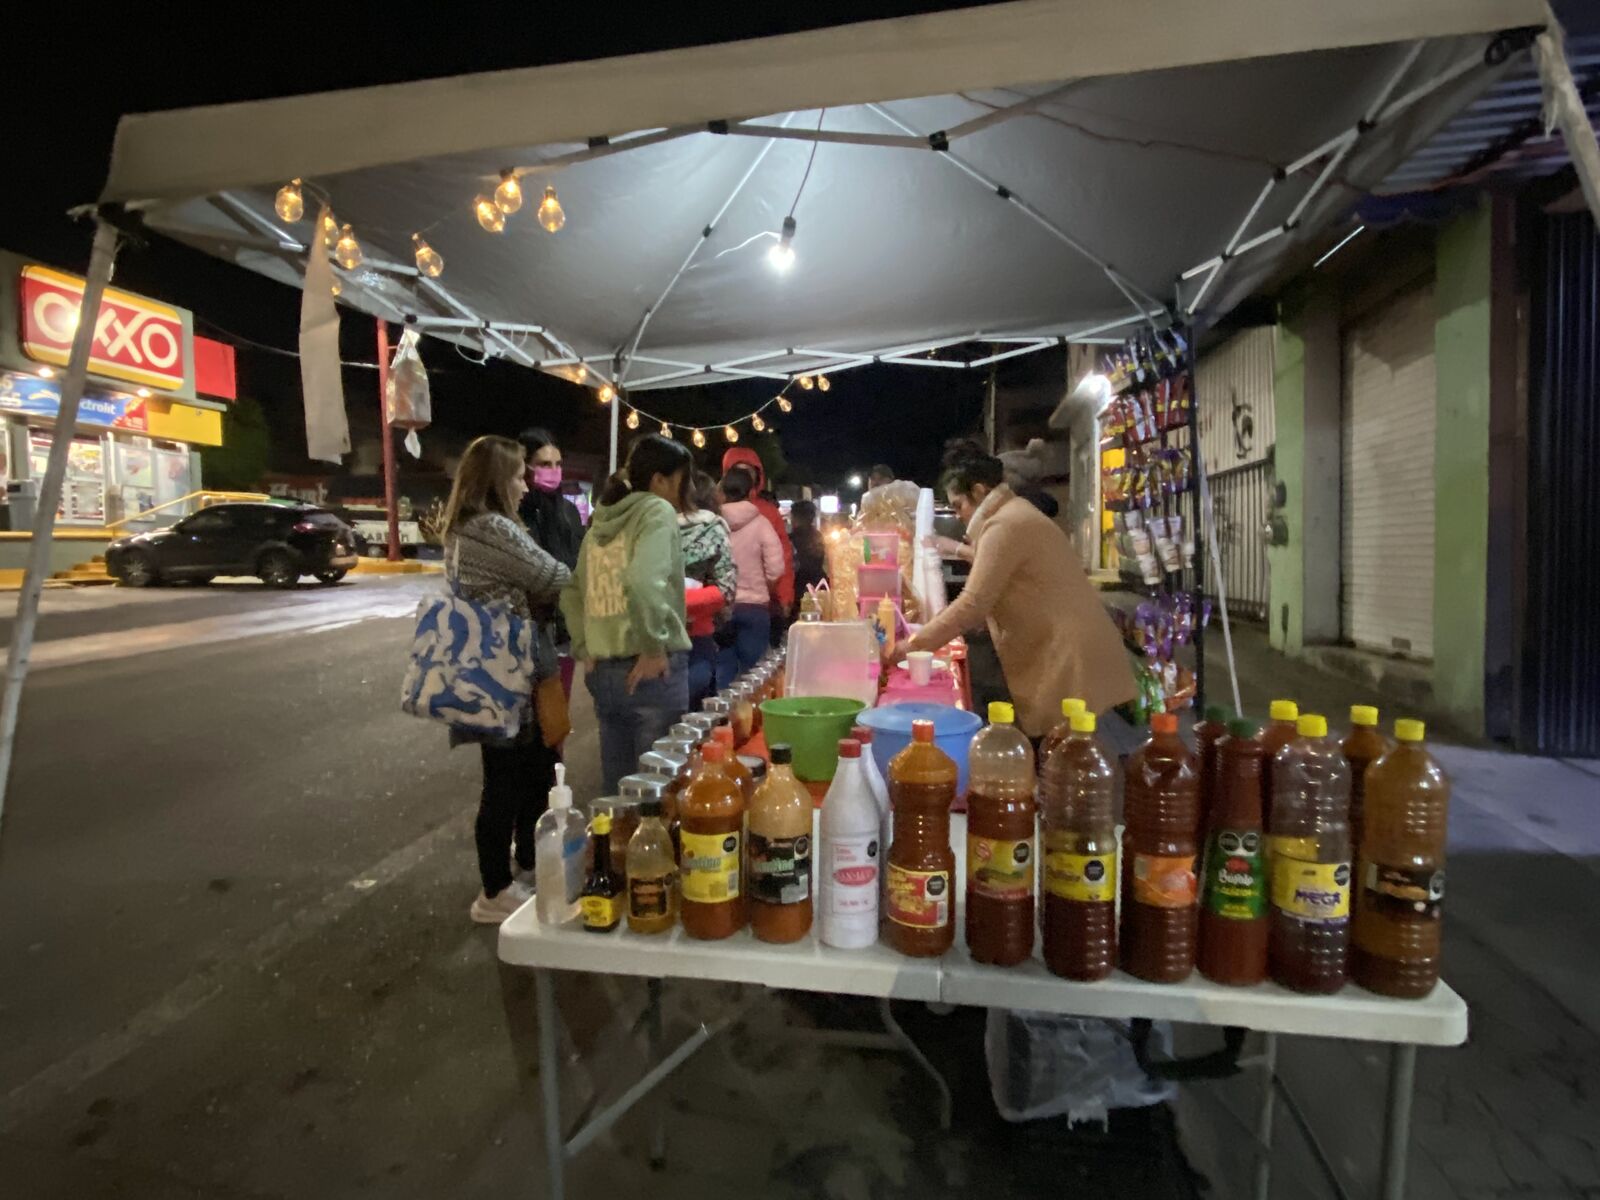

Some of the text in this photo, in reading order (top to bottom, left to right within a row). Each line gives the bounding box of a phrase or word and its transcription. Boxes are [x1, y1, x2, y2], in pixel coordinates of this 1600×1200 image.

[33, 291, 178, 369] OXXO
[80, 398, 117, 415] ctrolit
[1293, 889, 1342, 906] MEGA
